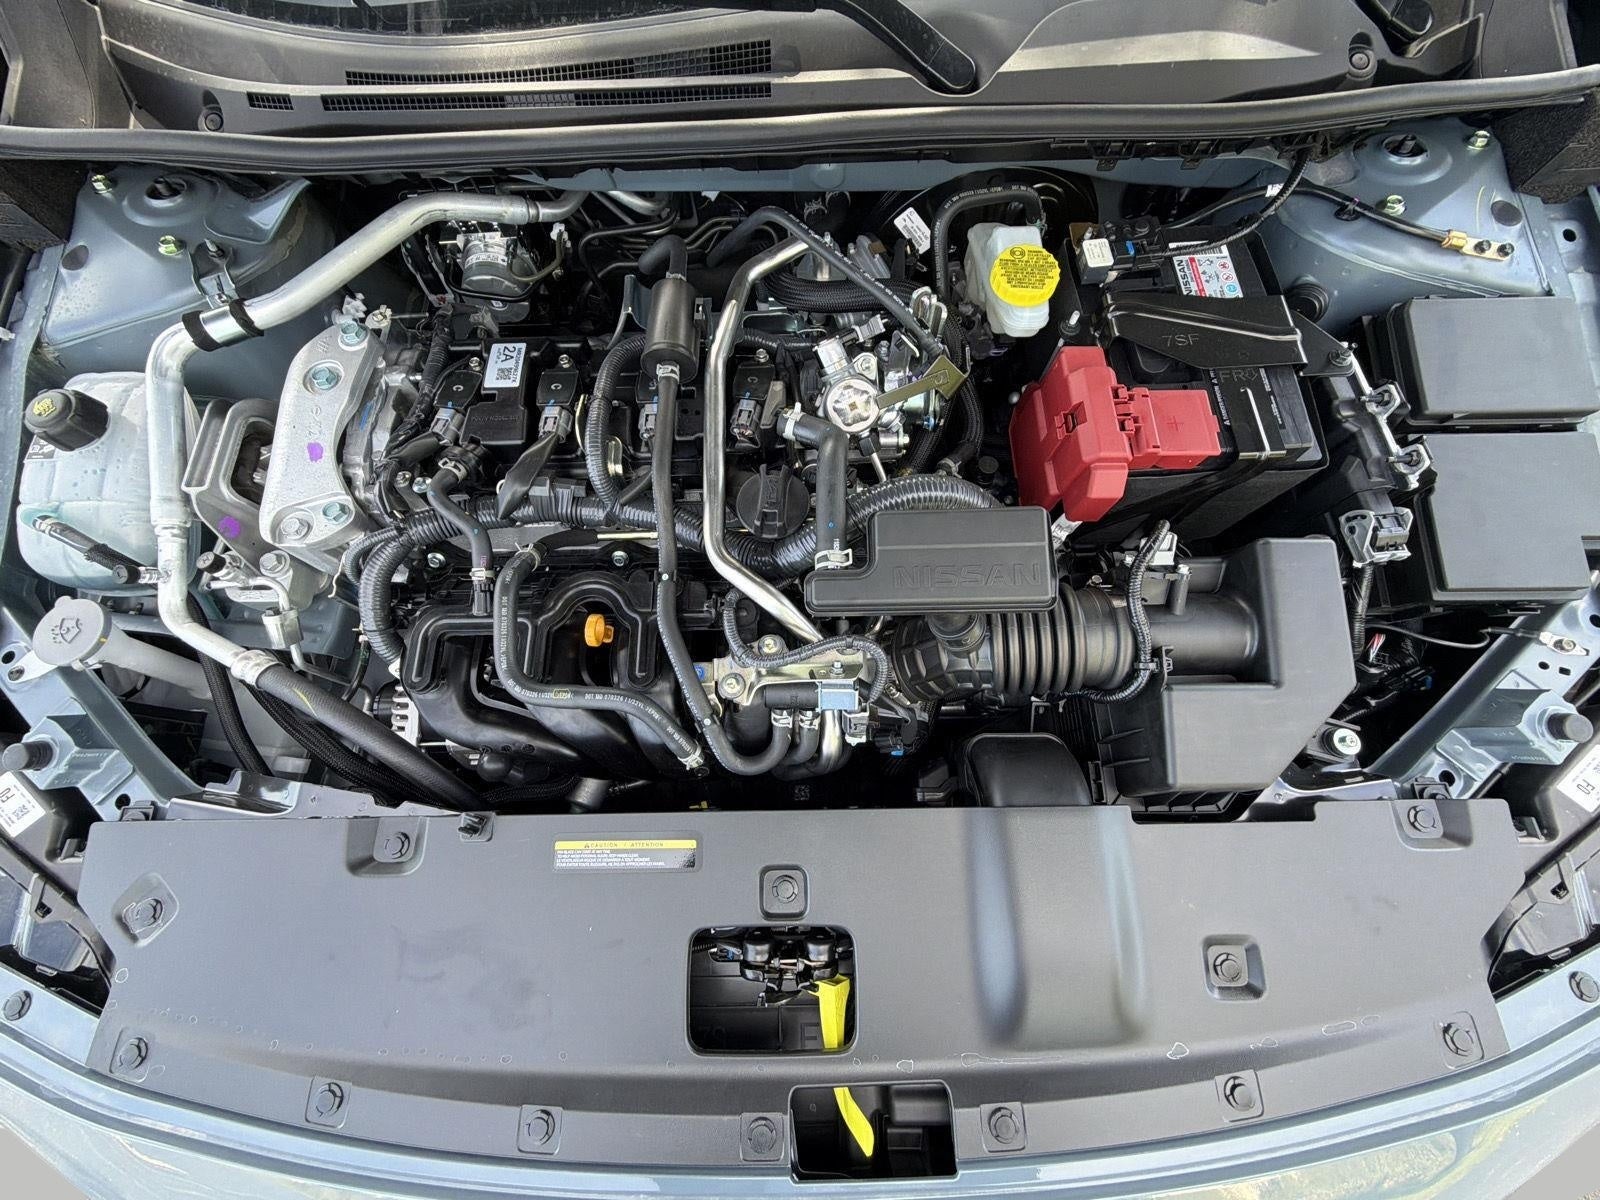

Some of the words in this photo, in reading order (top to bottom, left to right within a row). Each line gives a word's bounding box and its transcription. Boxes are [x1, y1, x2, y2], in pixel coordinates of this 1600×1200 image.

[1176, 259, 1193, 296] NISSAN
[1162, 333, 1199, 347] 7SF
[501, 346, 517, 363] 2A
[452, 384, 464, 392] C
[893, 563, 1041, 589] NISSAN
